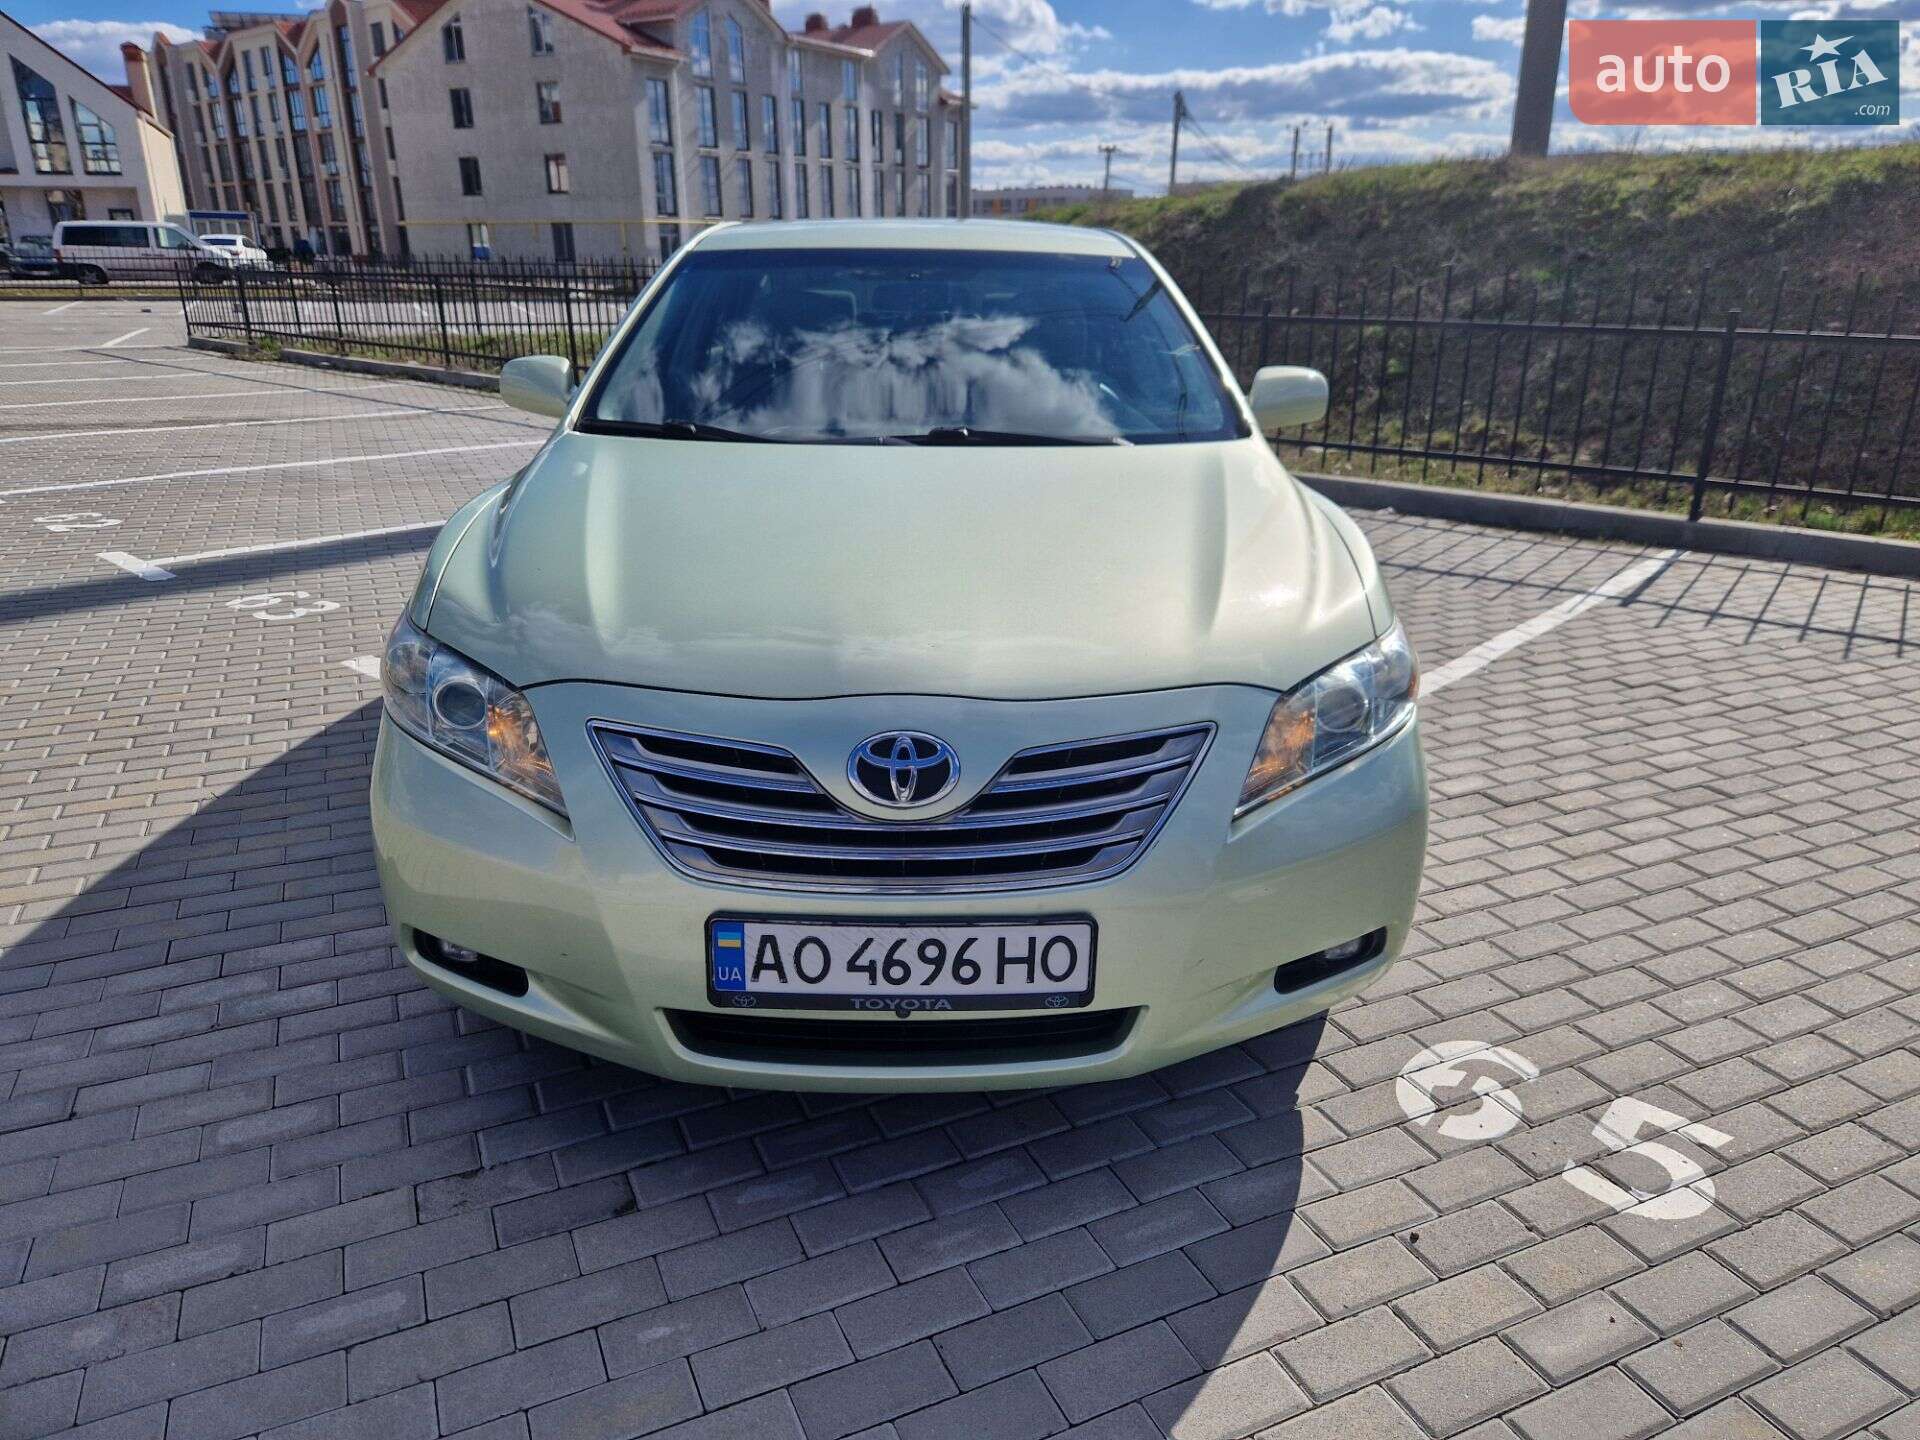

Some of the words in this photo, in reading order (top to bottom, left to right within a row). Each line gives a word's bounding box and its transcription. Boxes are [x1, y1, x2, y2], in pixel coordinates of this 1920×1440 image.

[750, 934, 832, 984] AO
[846, 937, 982, 986] 4696
[996, 935, 1078, 985] HO
[717, 966, 742, 982] UA
[850, 997, 952, 1010] TOYOTA
